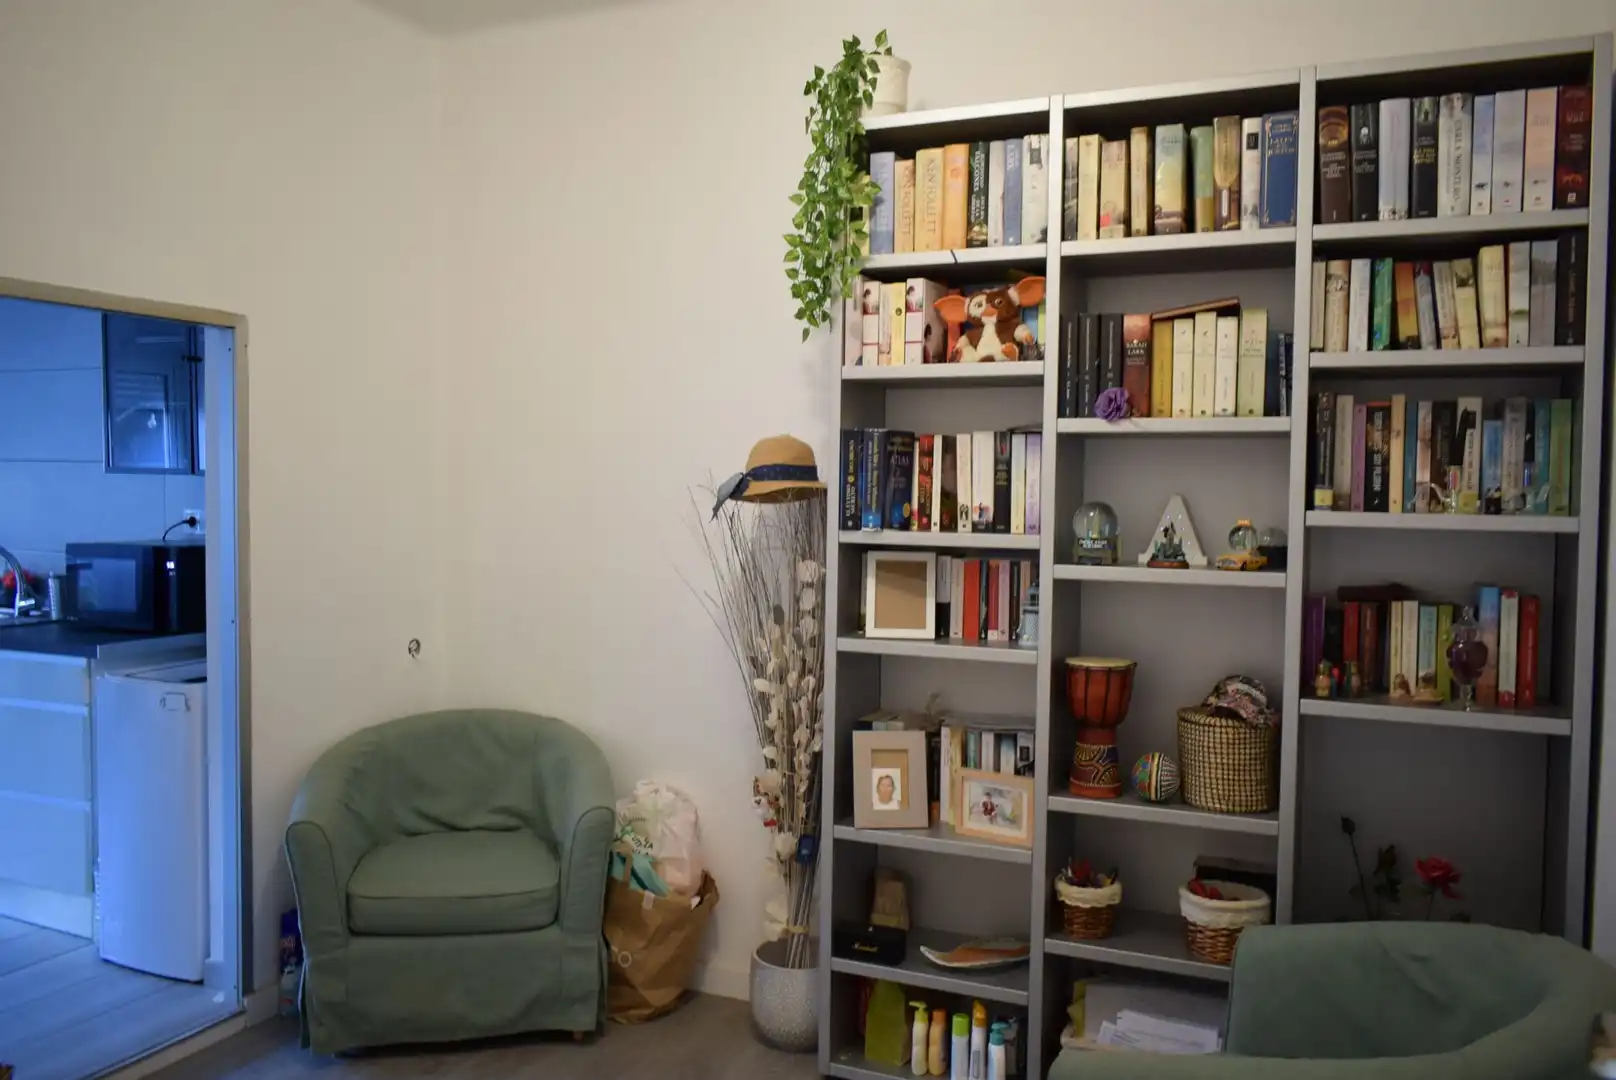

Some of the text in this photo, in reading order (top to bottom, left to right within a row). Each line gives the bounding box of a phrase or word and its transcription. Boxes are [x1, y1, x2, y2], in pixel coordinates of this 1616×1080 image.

[1453, 119, 1463, 202] CARLA MONTERO
[901, 166, 912, 236] KEN FOLLETT
[925, 158, 938, 236] KEN FOLLETT
[1126, 341, 1147, 349] SARAH
[890, 454, 909, 465] ATLAS
